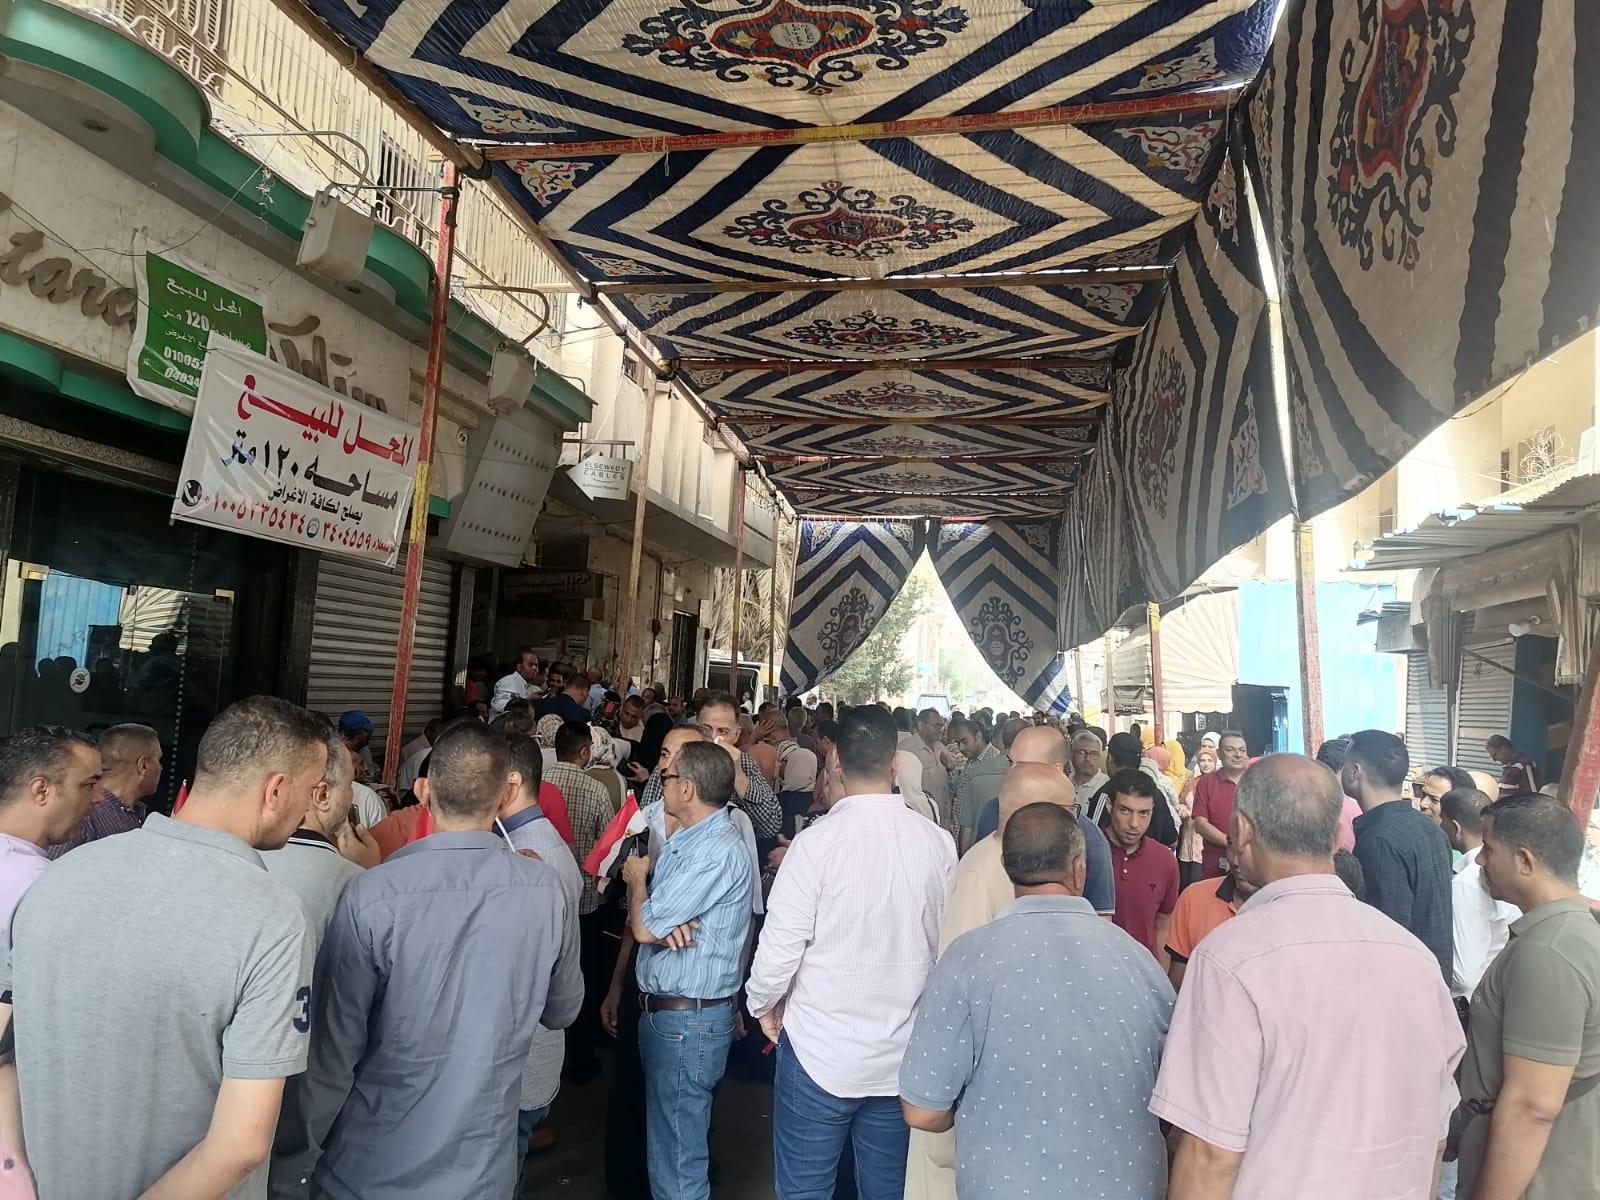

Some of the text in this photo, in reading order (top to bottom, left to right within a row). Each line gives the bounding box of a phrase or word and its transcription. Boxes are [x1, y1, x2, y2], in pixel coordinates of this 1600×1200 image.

[166, 277, 242, 318] المحل للبيع
[185, 309, 210, 332] 120
[237, 374, 415, 468] المحل للبيع
[221, 428, 257, 468] متر
[263, 440, 299, 480] ١٢٠
[583, 470, 625, 480] CABLES
[310, 492, 341, 515] لكافة
[340, 505, 363, 525] يصلح
[322, 520, 372, 550] ٣٤٠٤٥٥٩
[293, 985, 311, 1033] 3
